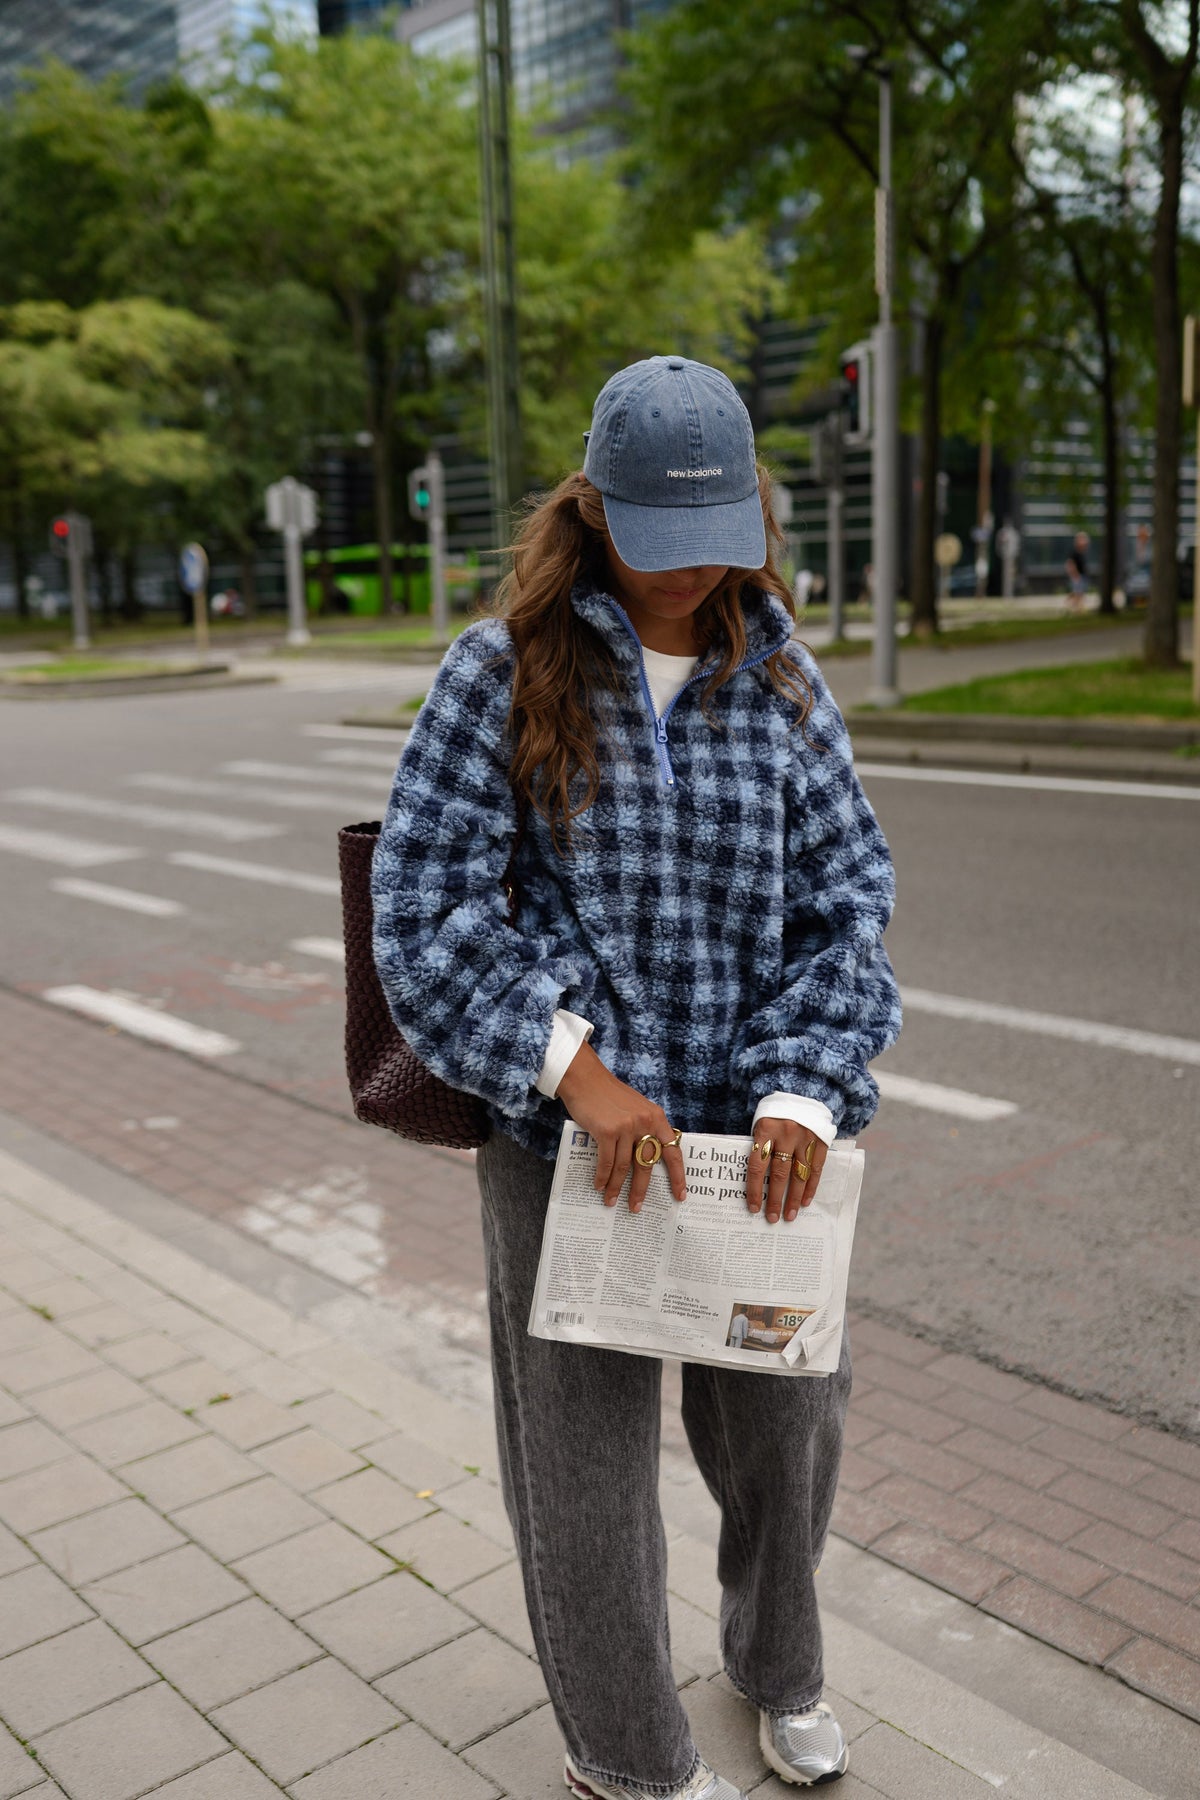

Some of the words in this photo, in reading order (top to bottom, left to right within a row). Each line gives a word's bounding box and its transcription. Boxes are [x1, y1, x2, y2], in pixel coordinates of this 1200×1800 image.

[667, 470, 685, 478] new
[687, 468, 723, 478] balance
[688, 1146, 707, 1160] Le
[711, 1147, 750, 1168] budge
[686, 1166, 714, 1179] met
[685, 1184, 715, 1196] sous
